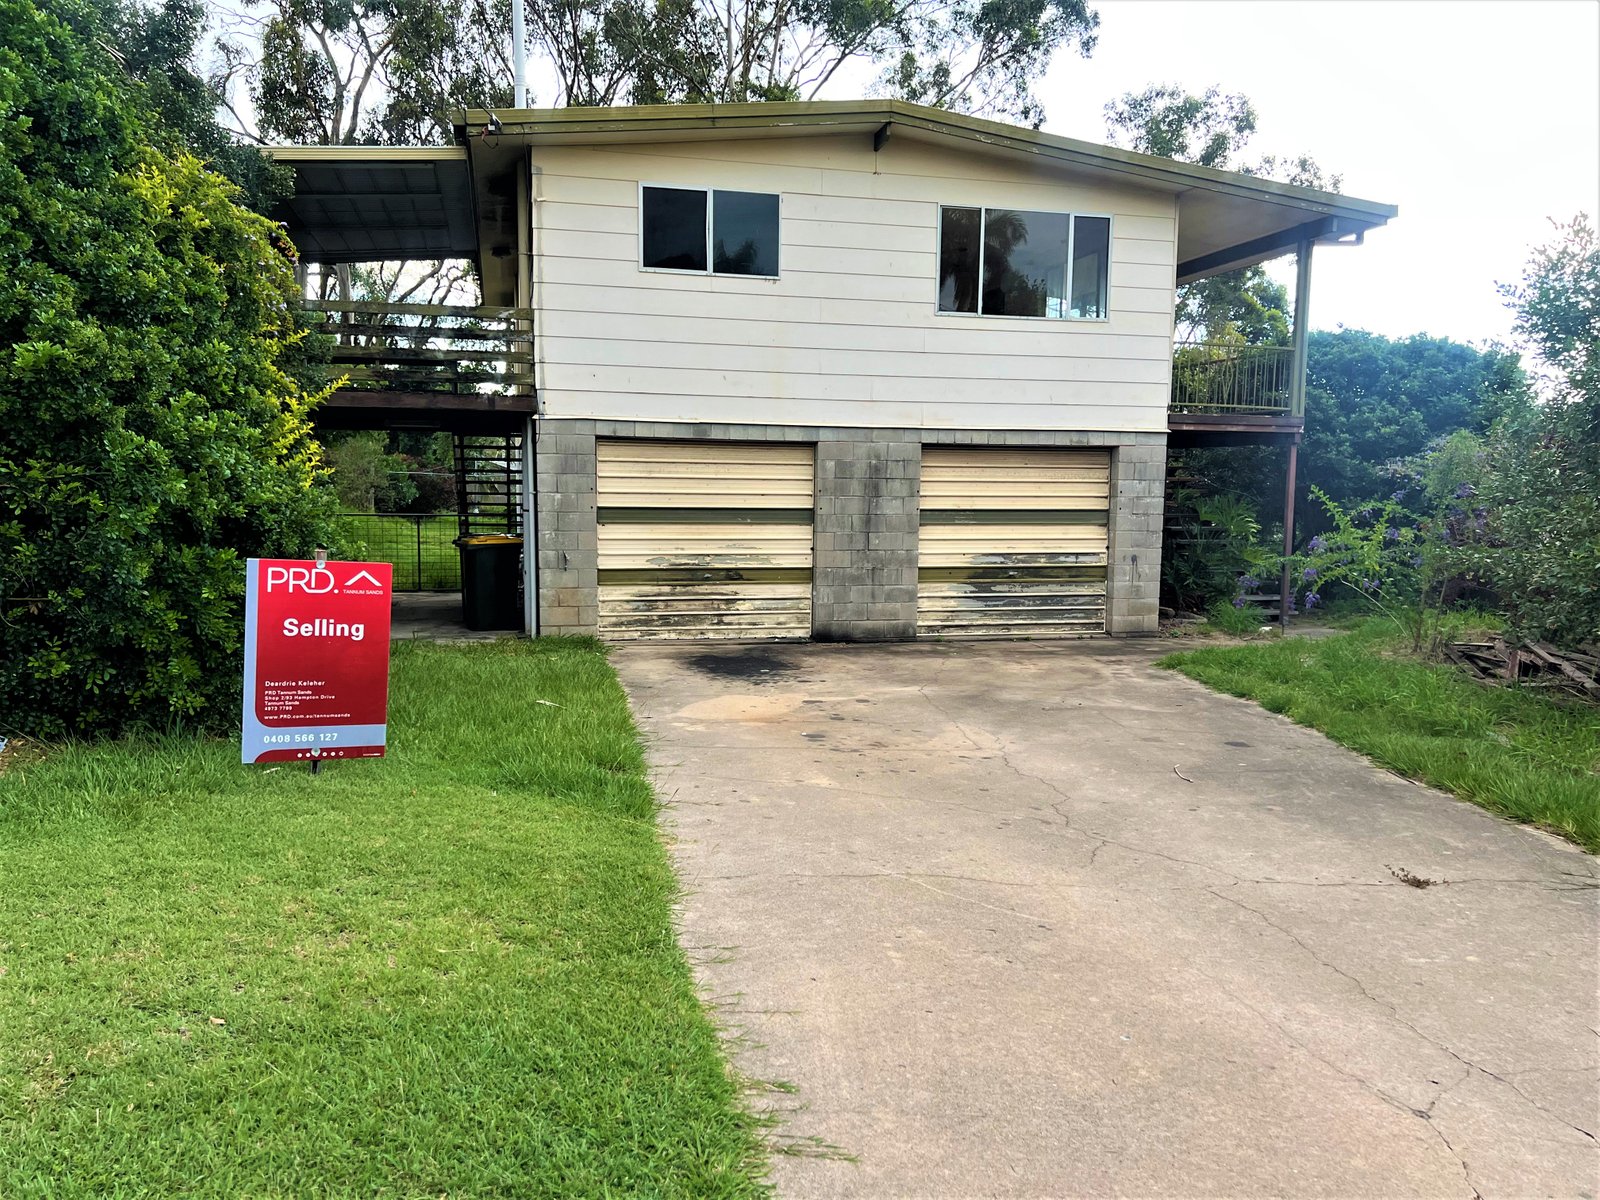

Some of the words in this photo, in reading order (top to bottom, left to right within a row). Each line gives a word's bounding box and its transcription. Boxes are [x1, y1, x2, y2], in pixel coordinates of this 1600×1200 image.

[267, 567, 339, 594] PRD.
[283, 618, 364, 640] Selling
[264, 735, 290, 744] 0408
[320, 733, 338, 741] 127
